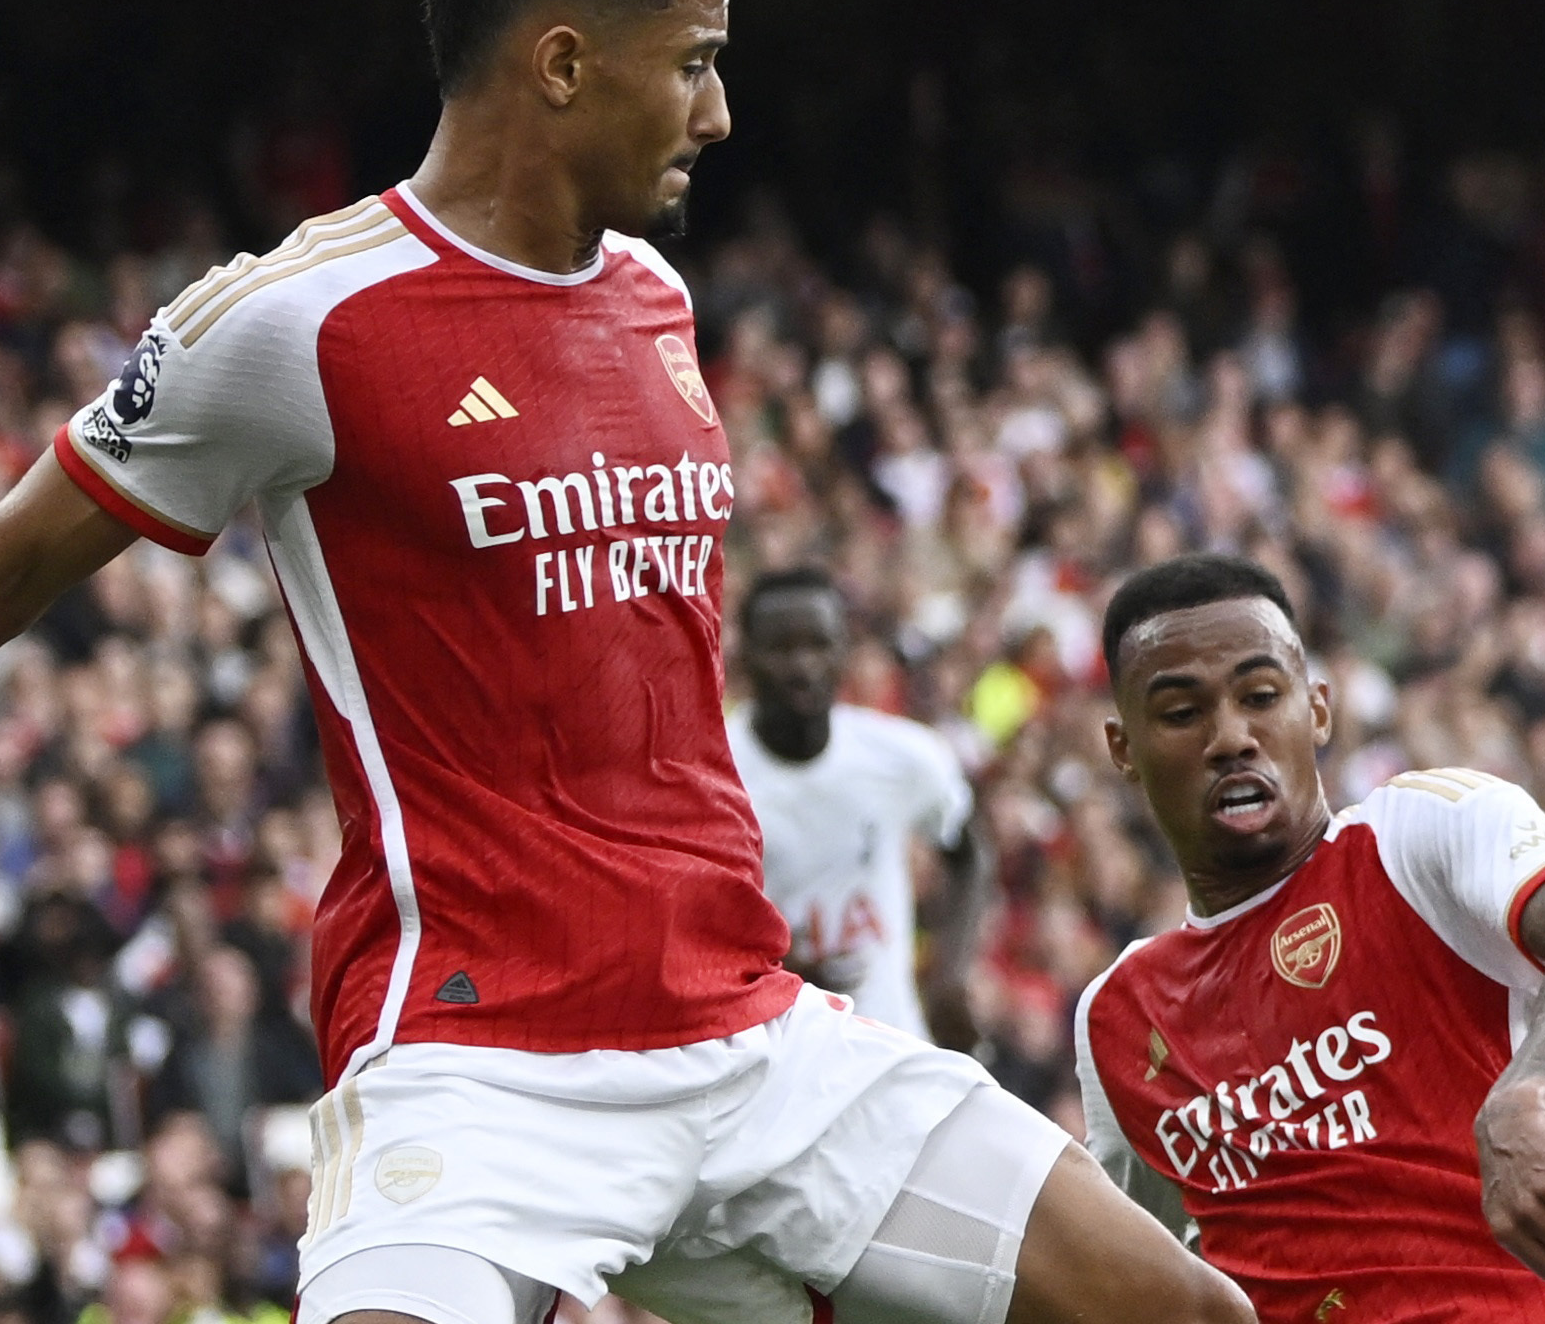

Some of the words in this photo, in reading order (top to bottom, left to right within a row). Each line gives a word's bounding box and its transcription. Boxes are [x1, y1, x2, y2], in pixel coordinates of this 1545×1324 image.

[448, 449, 735, 549] Emirates
[535, 544, 594, 617] FLY
[607, 534, 714, 603] BETTER
[1279, 914, 1327, 950] Arsenal
